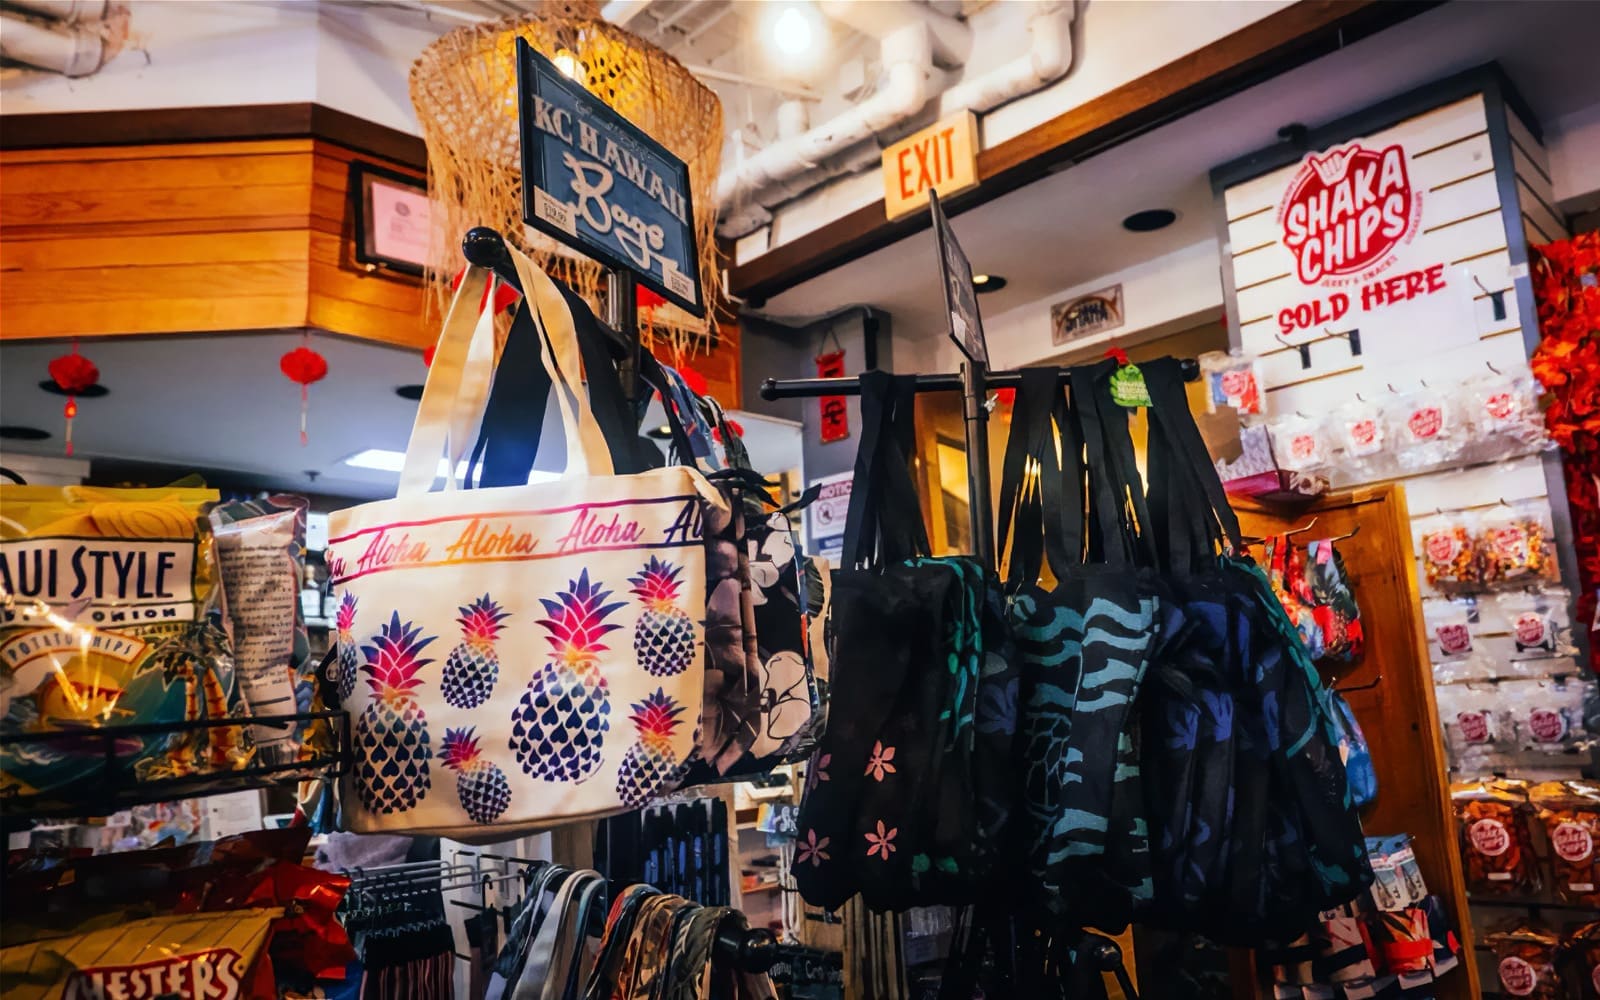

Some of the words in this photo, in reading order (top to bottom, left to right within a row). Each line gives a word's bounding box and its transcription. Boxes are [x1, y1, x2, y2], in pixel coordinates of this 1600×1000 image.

[531, 93, 574, 146] KC
[577, 119, 689, 226] HAWAII
[898, 127, 955, 200] EXIT
[1287, 149, 1404, 246] SHAKA
[1301, 193, 1405, 282] CHIPS
[1278, 292, 1349, 335] SOLD
[1361, 263, 1447, 311] HERE
[819, 481, 853, 499] NOTIC
[71, 545, 175, 599] STYLE
[357, 527, 430, 571] Aloha
[445, 514, 539, 562] Aloha
[556, 506, 645, 554] Aloha
[89, 634, 134, 655] HIPS
[91, 608, 177, 622] ONION
